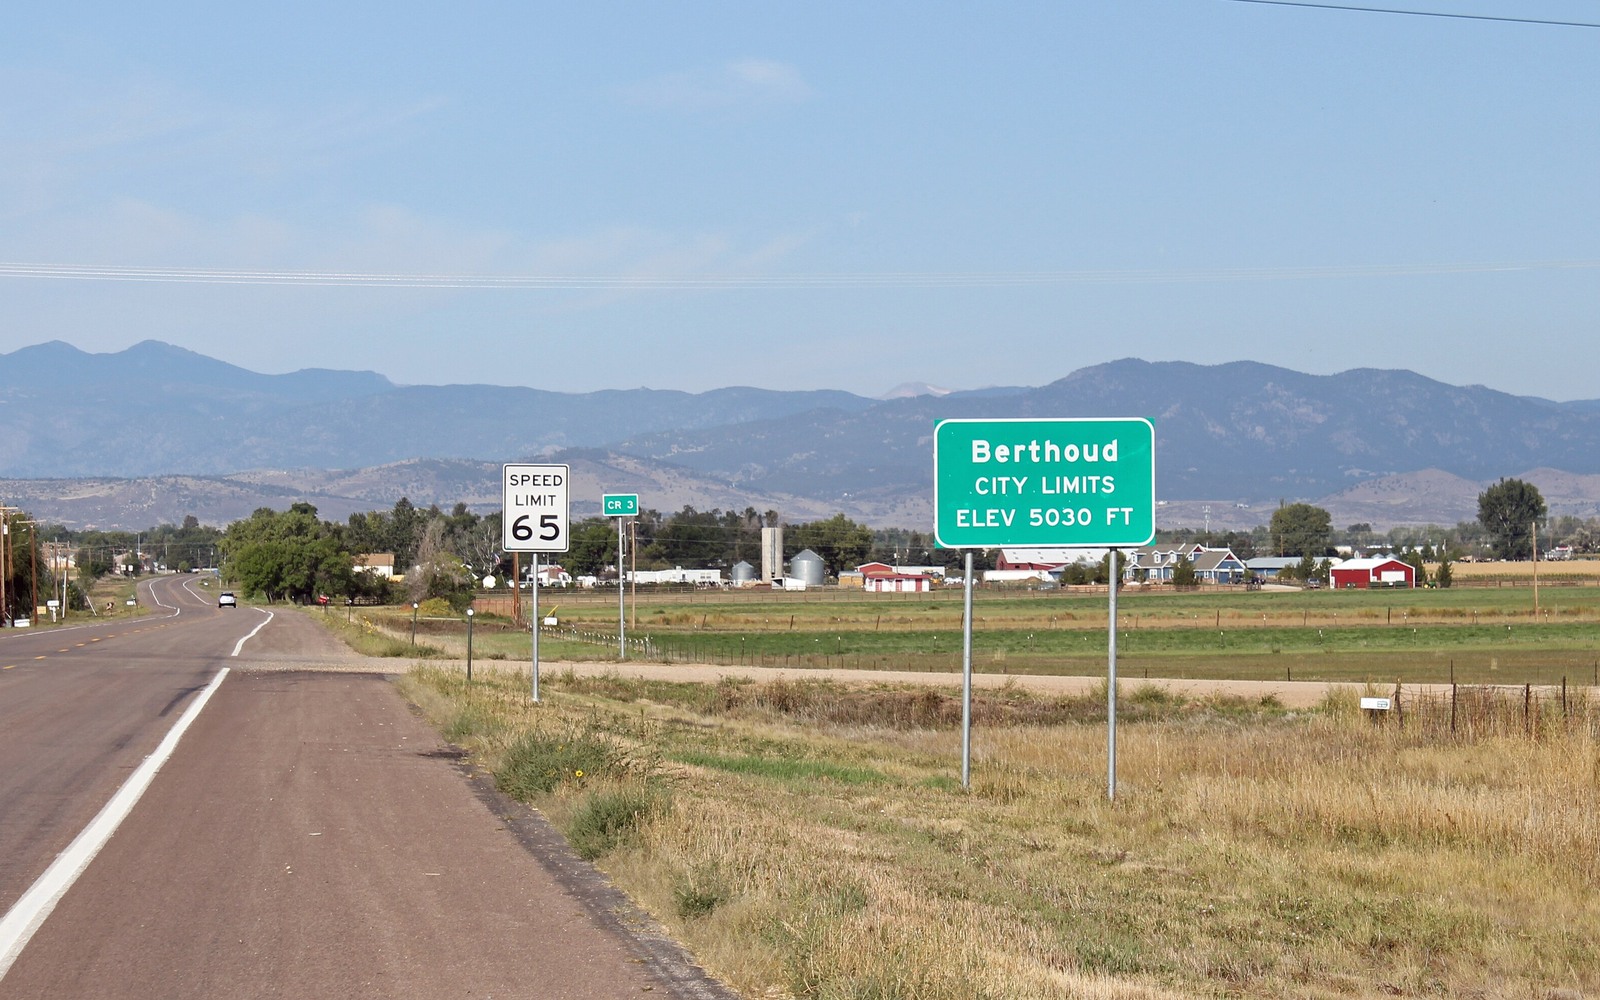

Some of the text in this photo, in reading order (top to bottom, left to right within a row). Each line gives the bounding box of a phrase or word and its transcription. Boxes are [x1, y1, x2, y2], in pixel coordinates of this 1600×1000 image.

[971, 438, 1118, 463] Berthoud
[510, 474, 563, 487] SPEED
[975, 475, 1115, 495] CITY LIMITS
[515, 494, 556, 506] LIMIT
[607, 500, 634, 510] CR 3
[956, 507, 1134, 527] ELEV 5030 FT
[512, 514, 560, 541] 65
